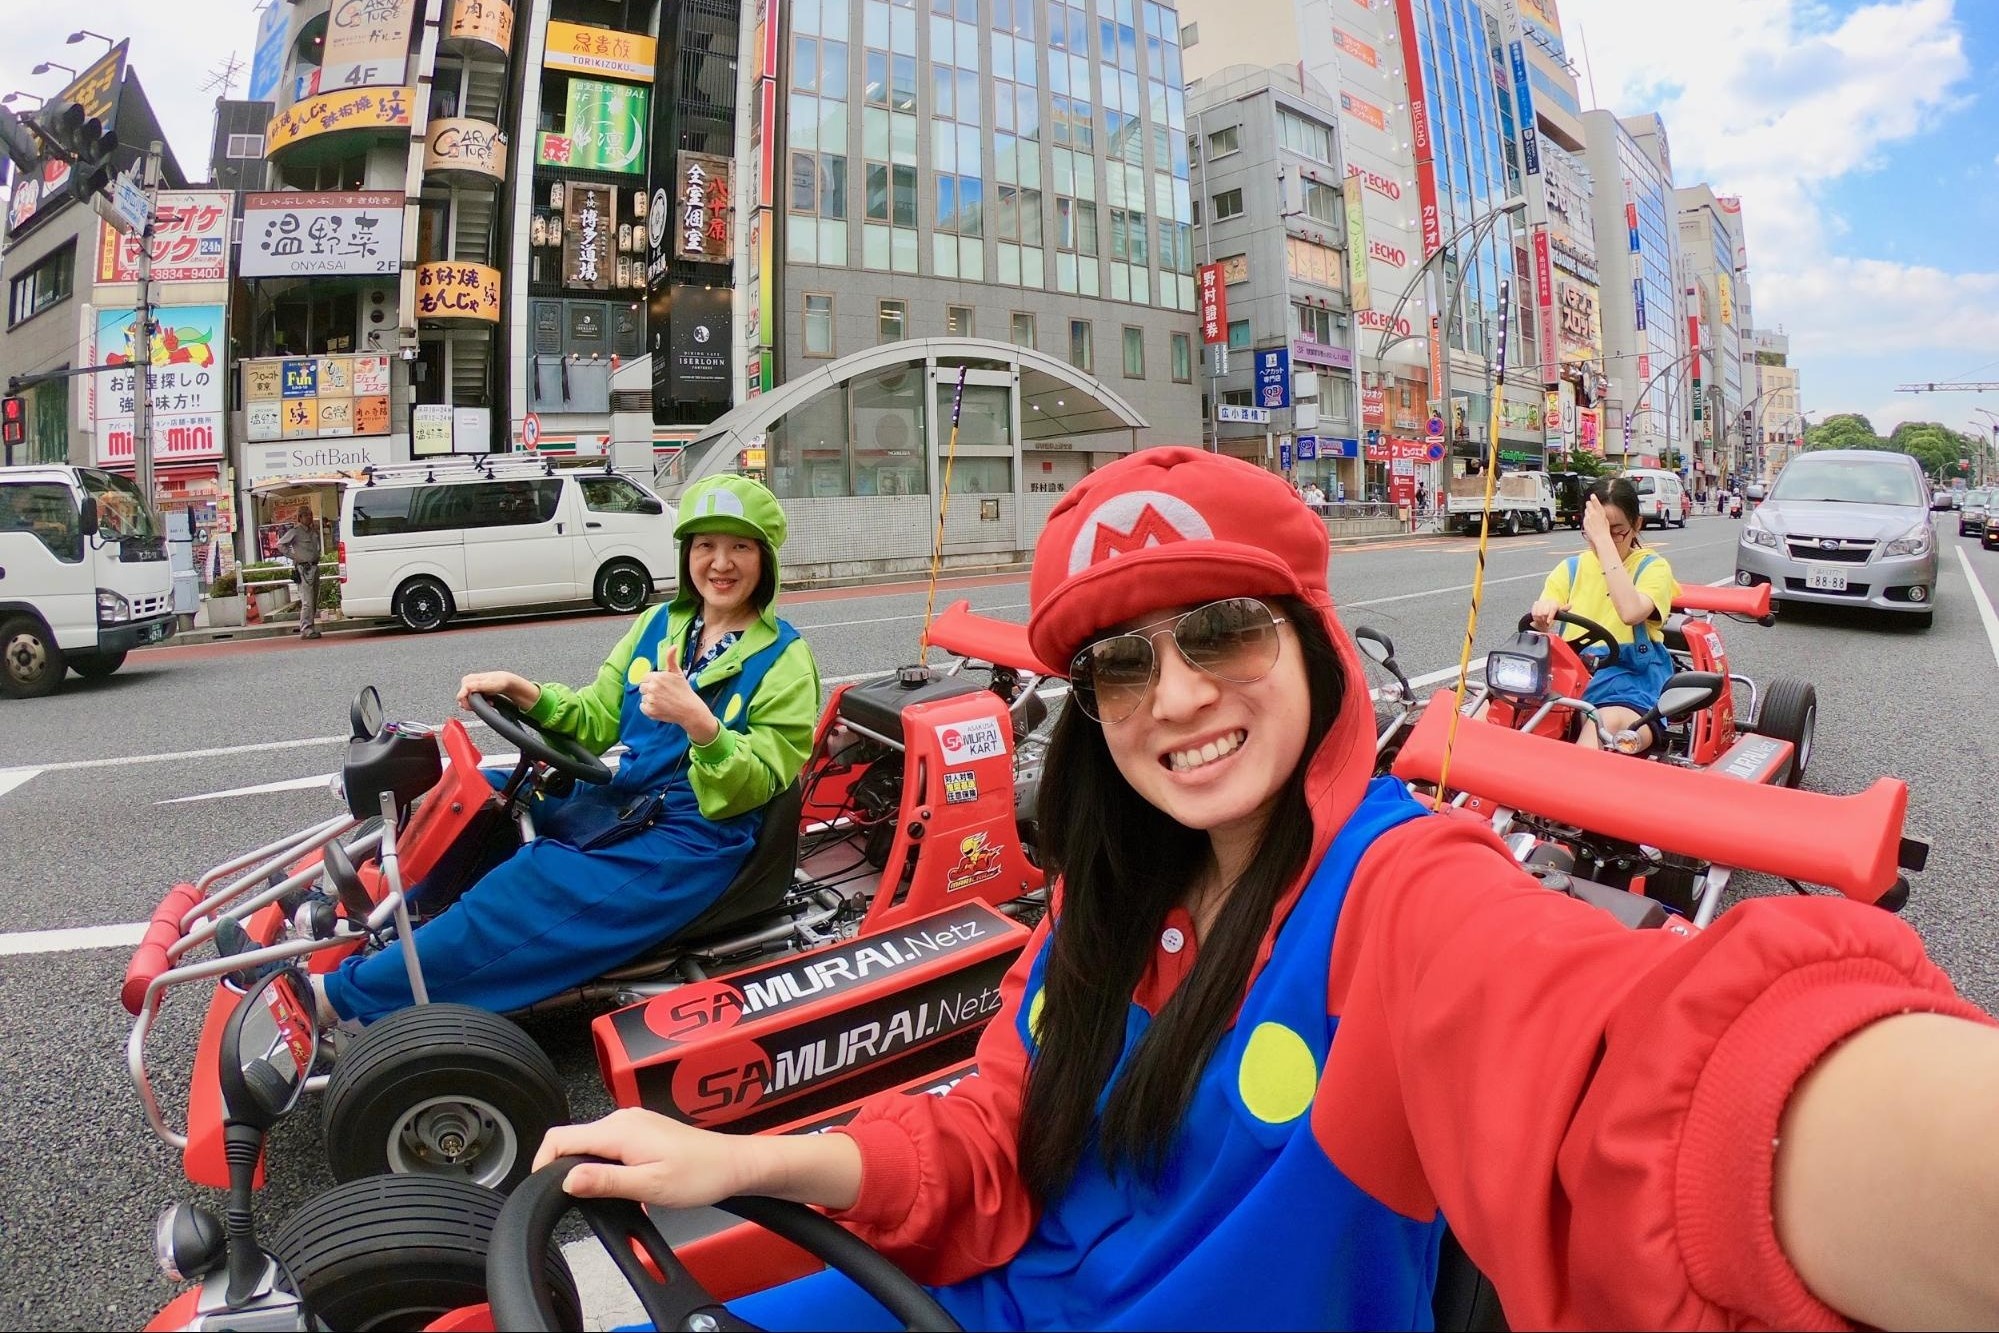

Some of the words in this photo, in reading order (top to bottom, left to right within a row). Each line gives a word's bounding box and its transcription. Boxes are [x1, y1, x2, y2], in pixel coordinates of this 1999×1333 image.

[572, 55, 630, 71] TORIKIZOKU
[345, 64, 378, 85] 4F
[625, 88, 645, 99] BAL
[1412, 100, 1422, 119] BIG
[1415, 119, 1427, 148] ECHO
[1369, 173, 1401, 200] ECHO
[683, 163, 706, 251] 全室個室
[706, 176, 729, 241] 八十席
[155, 205, 224, 233] ラオケ
[260, 211, 380, 258] 温野菜
[201, 240, 220, 253] 24h
[1374, 241, 1406, 269] ECHO
[132, 268, 220, 280] 0-3834-9400
[290, 260, 347, 271] ONYASAI
[376, 260, 397, 271] 2F
[419, 288, 479, 313] もんじゃ
[1203, 270, 1219, 339] 野村證券
[1359, 311, 1378, 326] BIG
[1379, 315, 1411, 338] ECHO
[679, 357, 725, 366] ISERLOHN
[287, 371, 312, 386] Fun
[355, 373, 379, 384] ジェイ
[363, 383, 388, 392] エステ
[120, 394, 201, 414] 強味方!!
[168, 426, 213, 451] mini
[292, 448, 370, 467] SoftBank
[1030, 482, 1065, 493] 野村證券
[1090, 502, 1188, 566] M
[1815, 576, 1844, 589] 88-88
[946, 729, 997, 746] SAMURAI
[969, 740, 997, 756] KART
